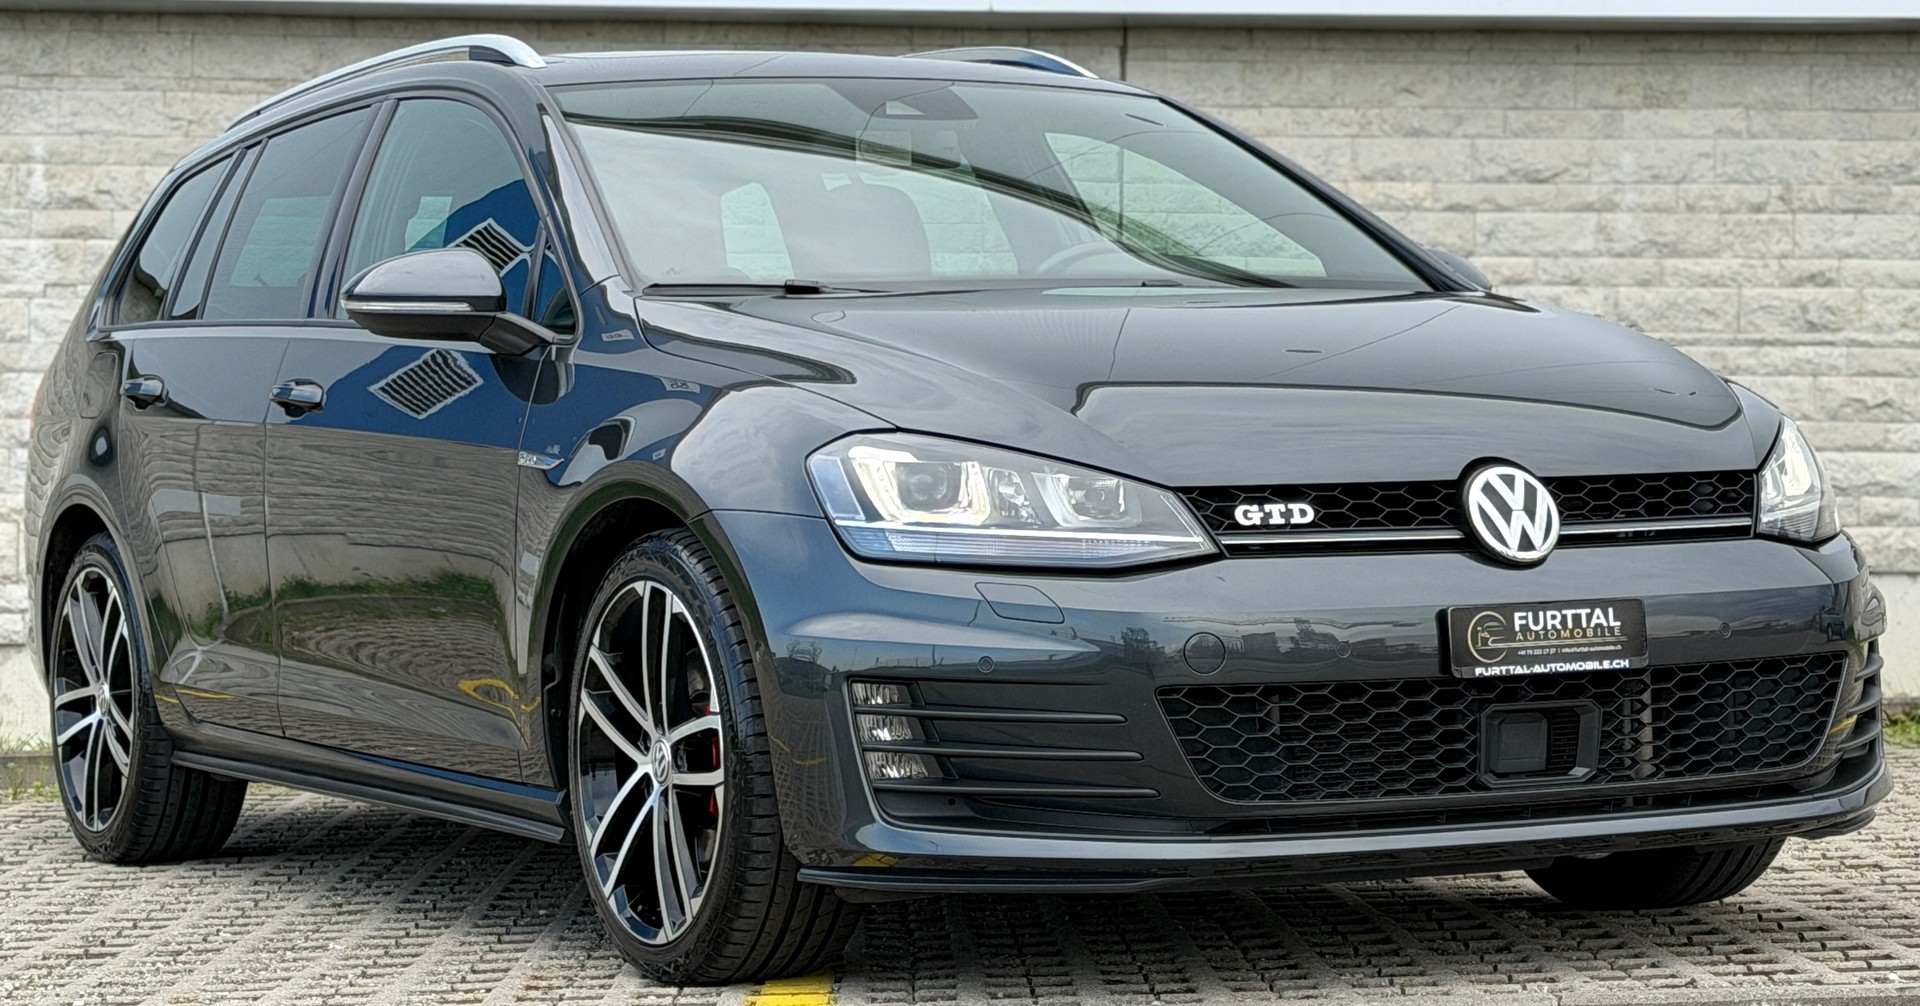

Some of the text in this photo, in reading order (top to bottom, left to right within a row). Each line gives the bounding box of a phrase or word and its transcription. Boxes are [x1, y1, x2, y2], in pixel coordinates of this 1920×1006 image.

[1234, 503, 1315, 526] GTD
[1471, 468, 1557, 557] VW
[1513, 607, 1622, 632] FURTTAL
[1515, 626, 1622, 641] AUTOMOBILE
[1475, 659, 1630, 677] FURTTAL-AUTOMOBILE.CH
